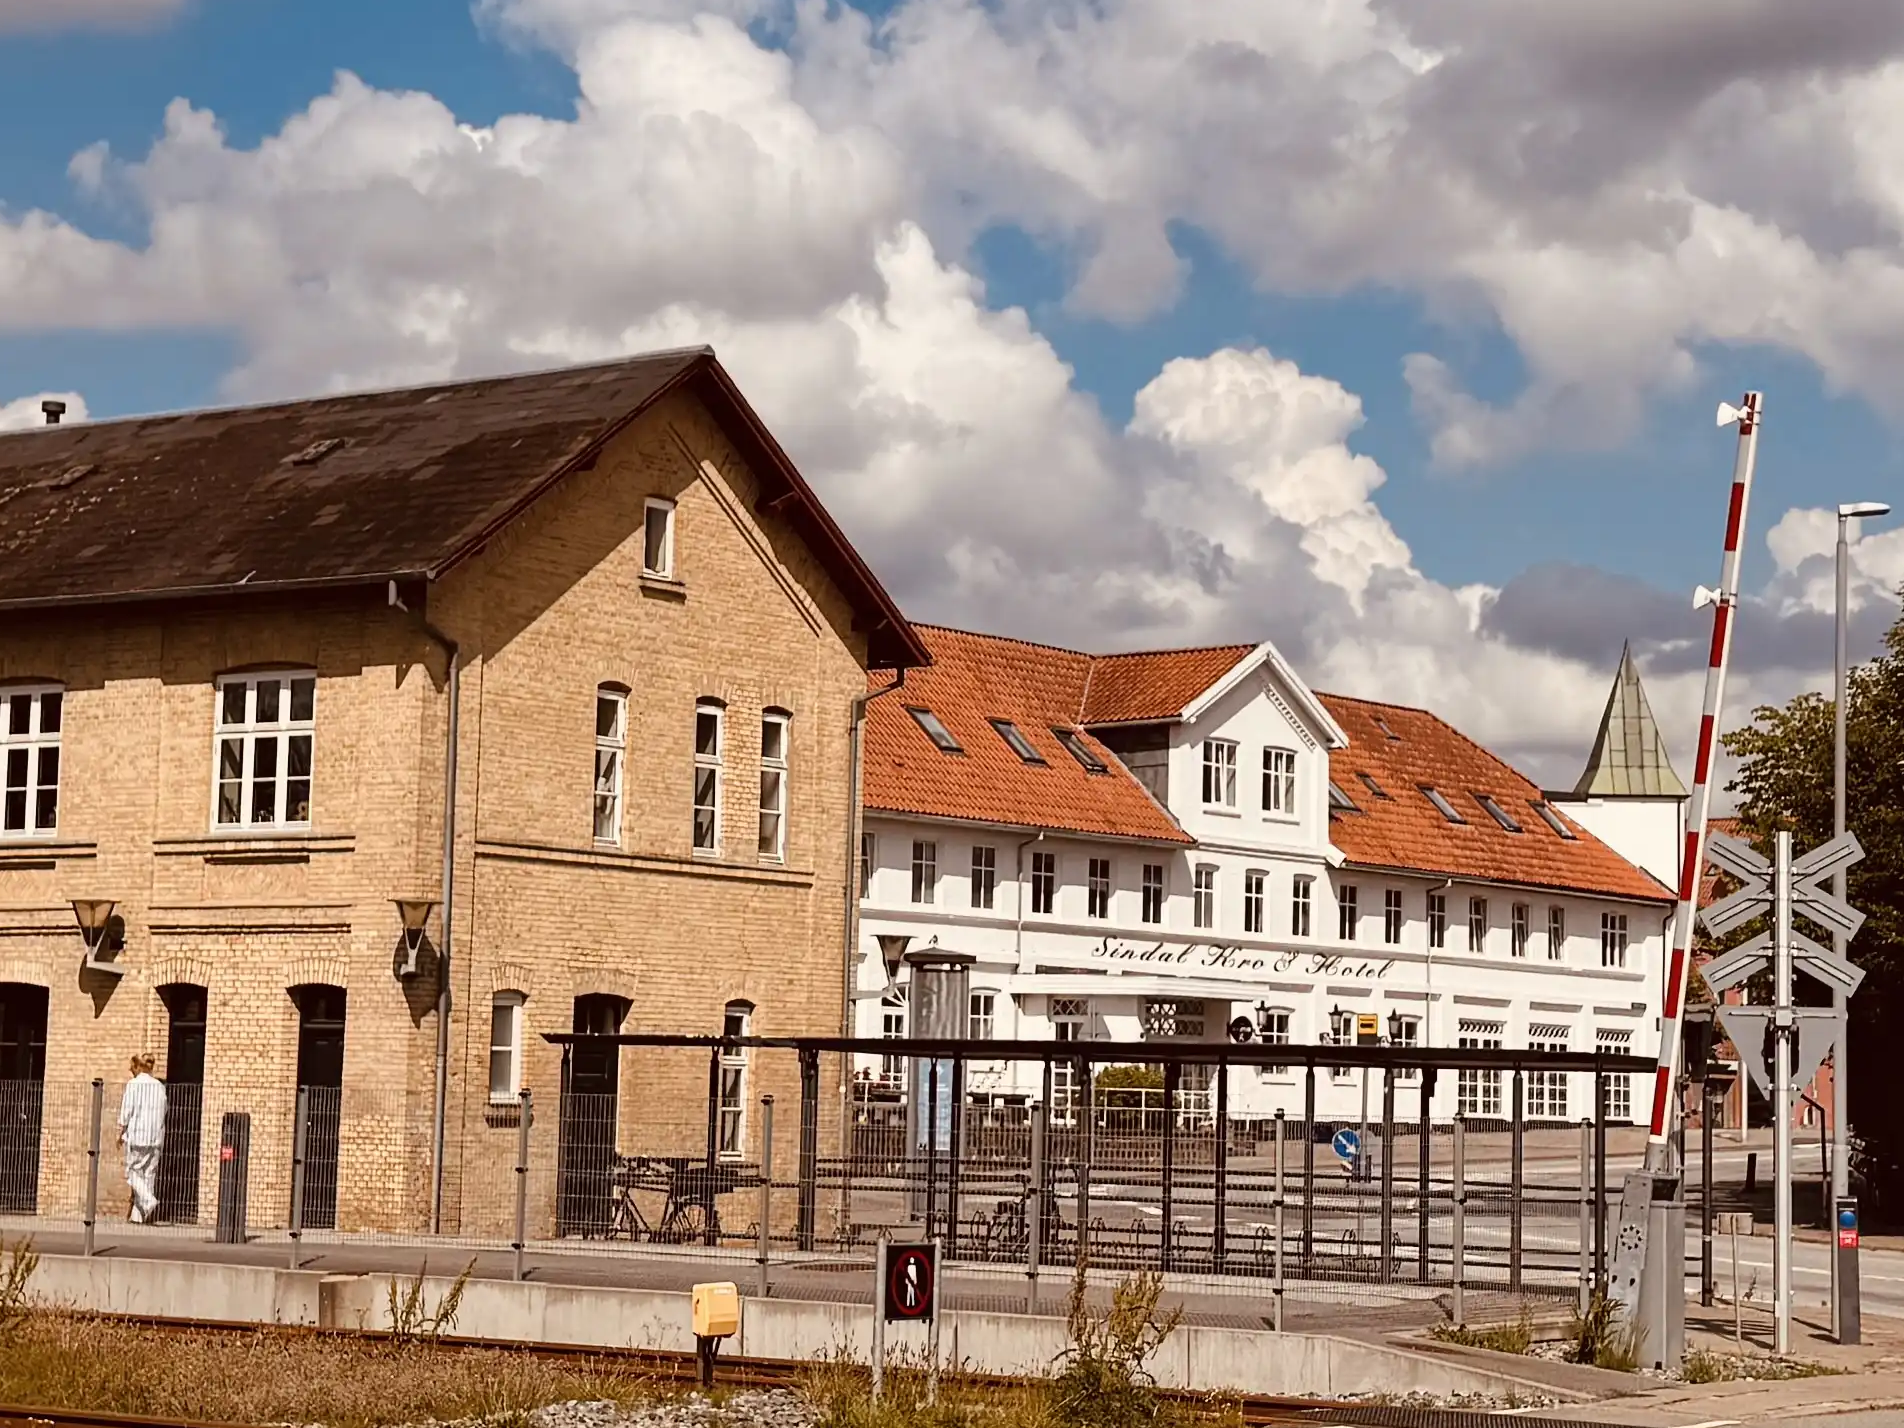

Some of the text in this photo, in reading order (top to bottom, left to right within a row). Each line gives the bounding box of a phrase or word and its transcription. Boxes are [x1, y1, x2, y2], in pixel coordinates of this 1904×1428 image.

[1091, 934, 1196, 964] Sindal
[1201, 943, 1264, 971] Kro
[1305, 952, 1396, 979] Hotel
